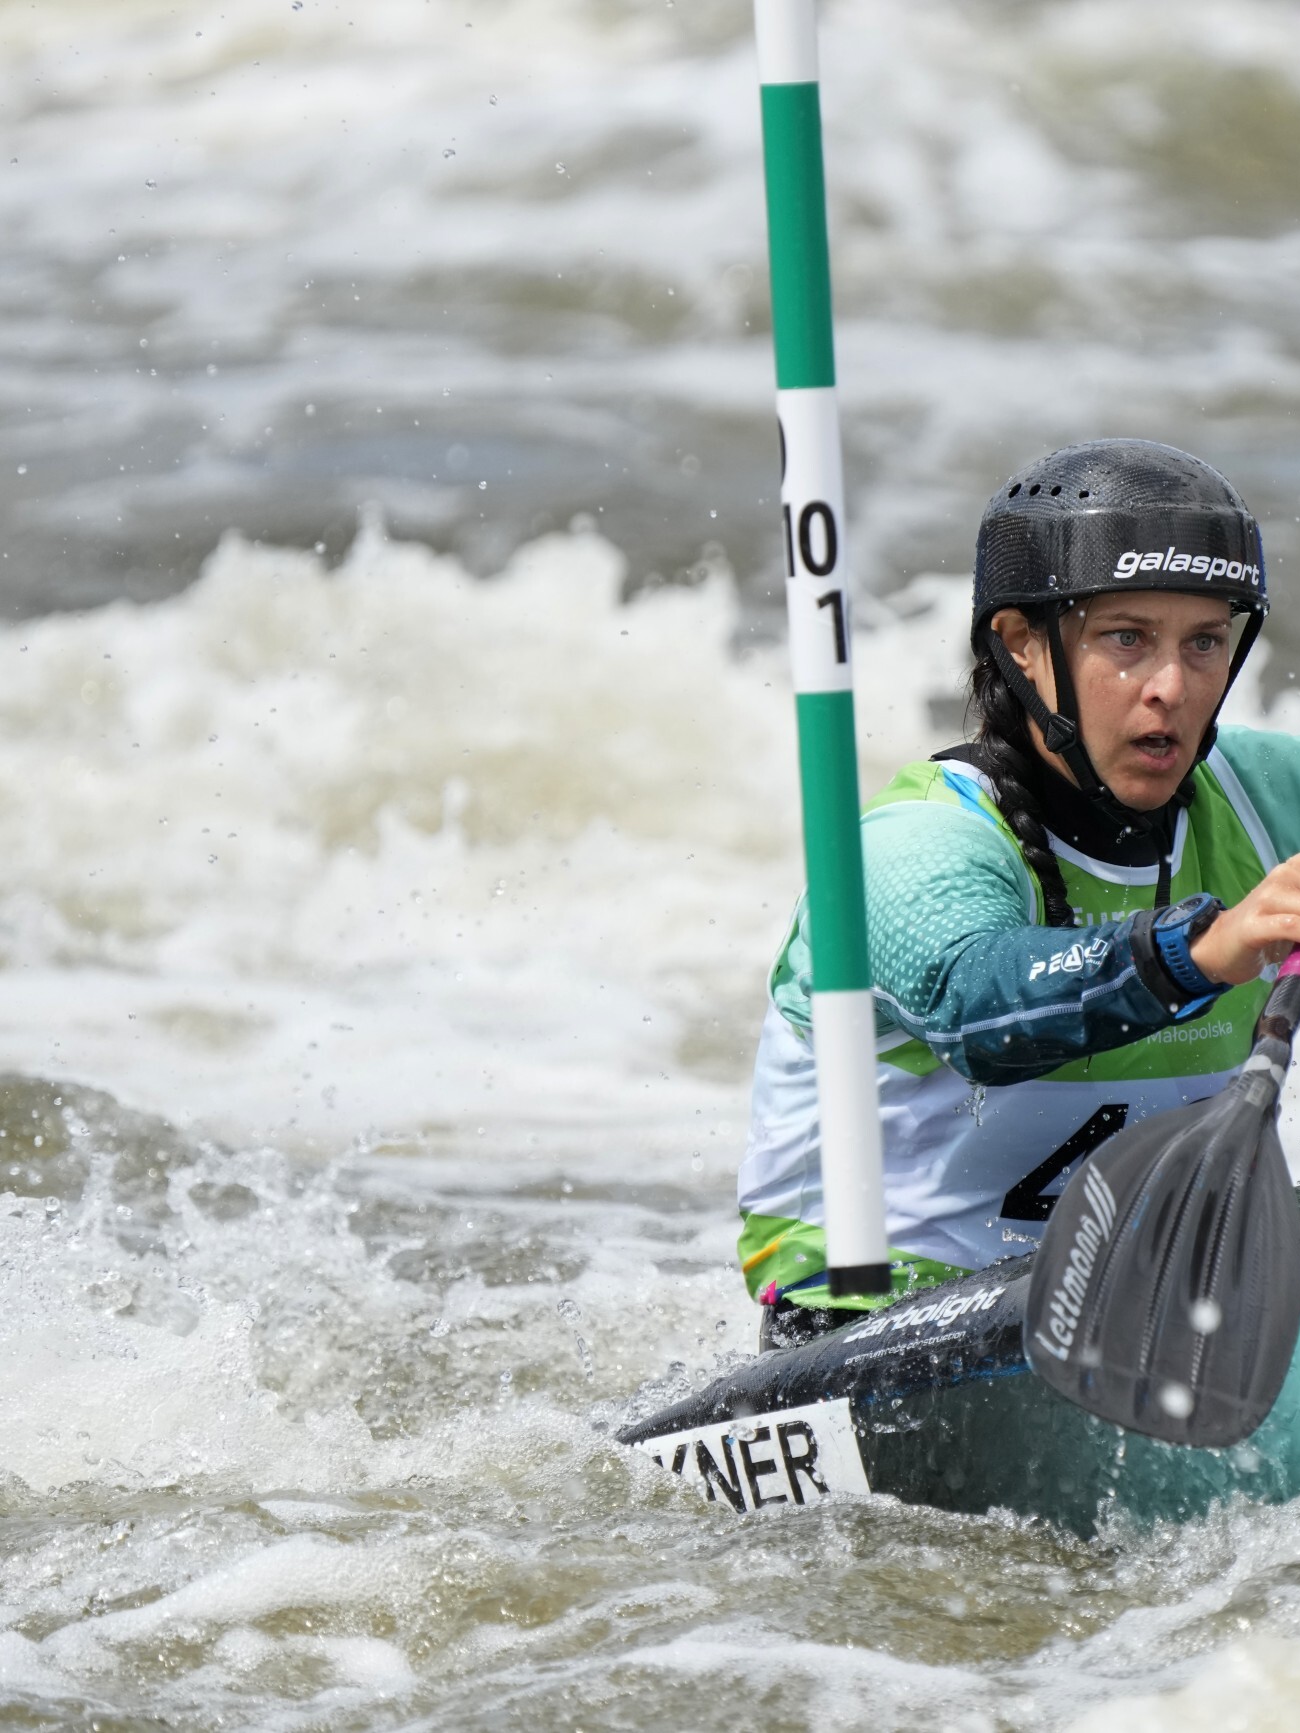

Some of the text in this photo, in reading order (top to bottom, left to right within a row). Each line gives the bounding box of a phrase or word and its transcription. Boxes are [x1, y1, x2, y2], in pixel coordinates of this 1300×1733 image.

[1113, 547, 1260, 586] galasport
[816, 588, 848, 664] 1
[1146, 1021, 1233, 1045] Małopolska
[1035, 1214, 1101, 1362] Lettmann
